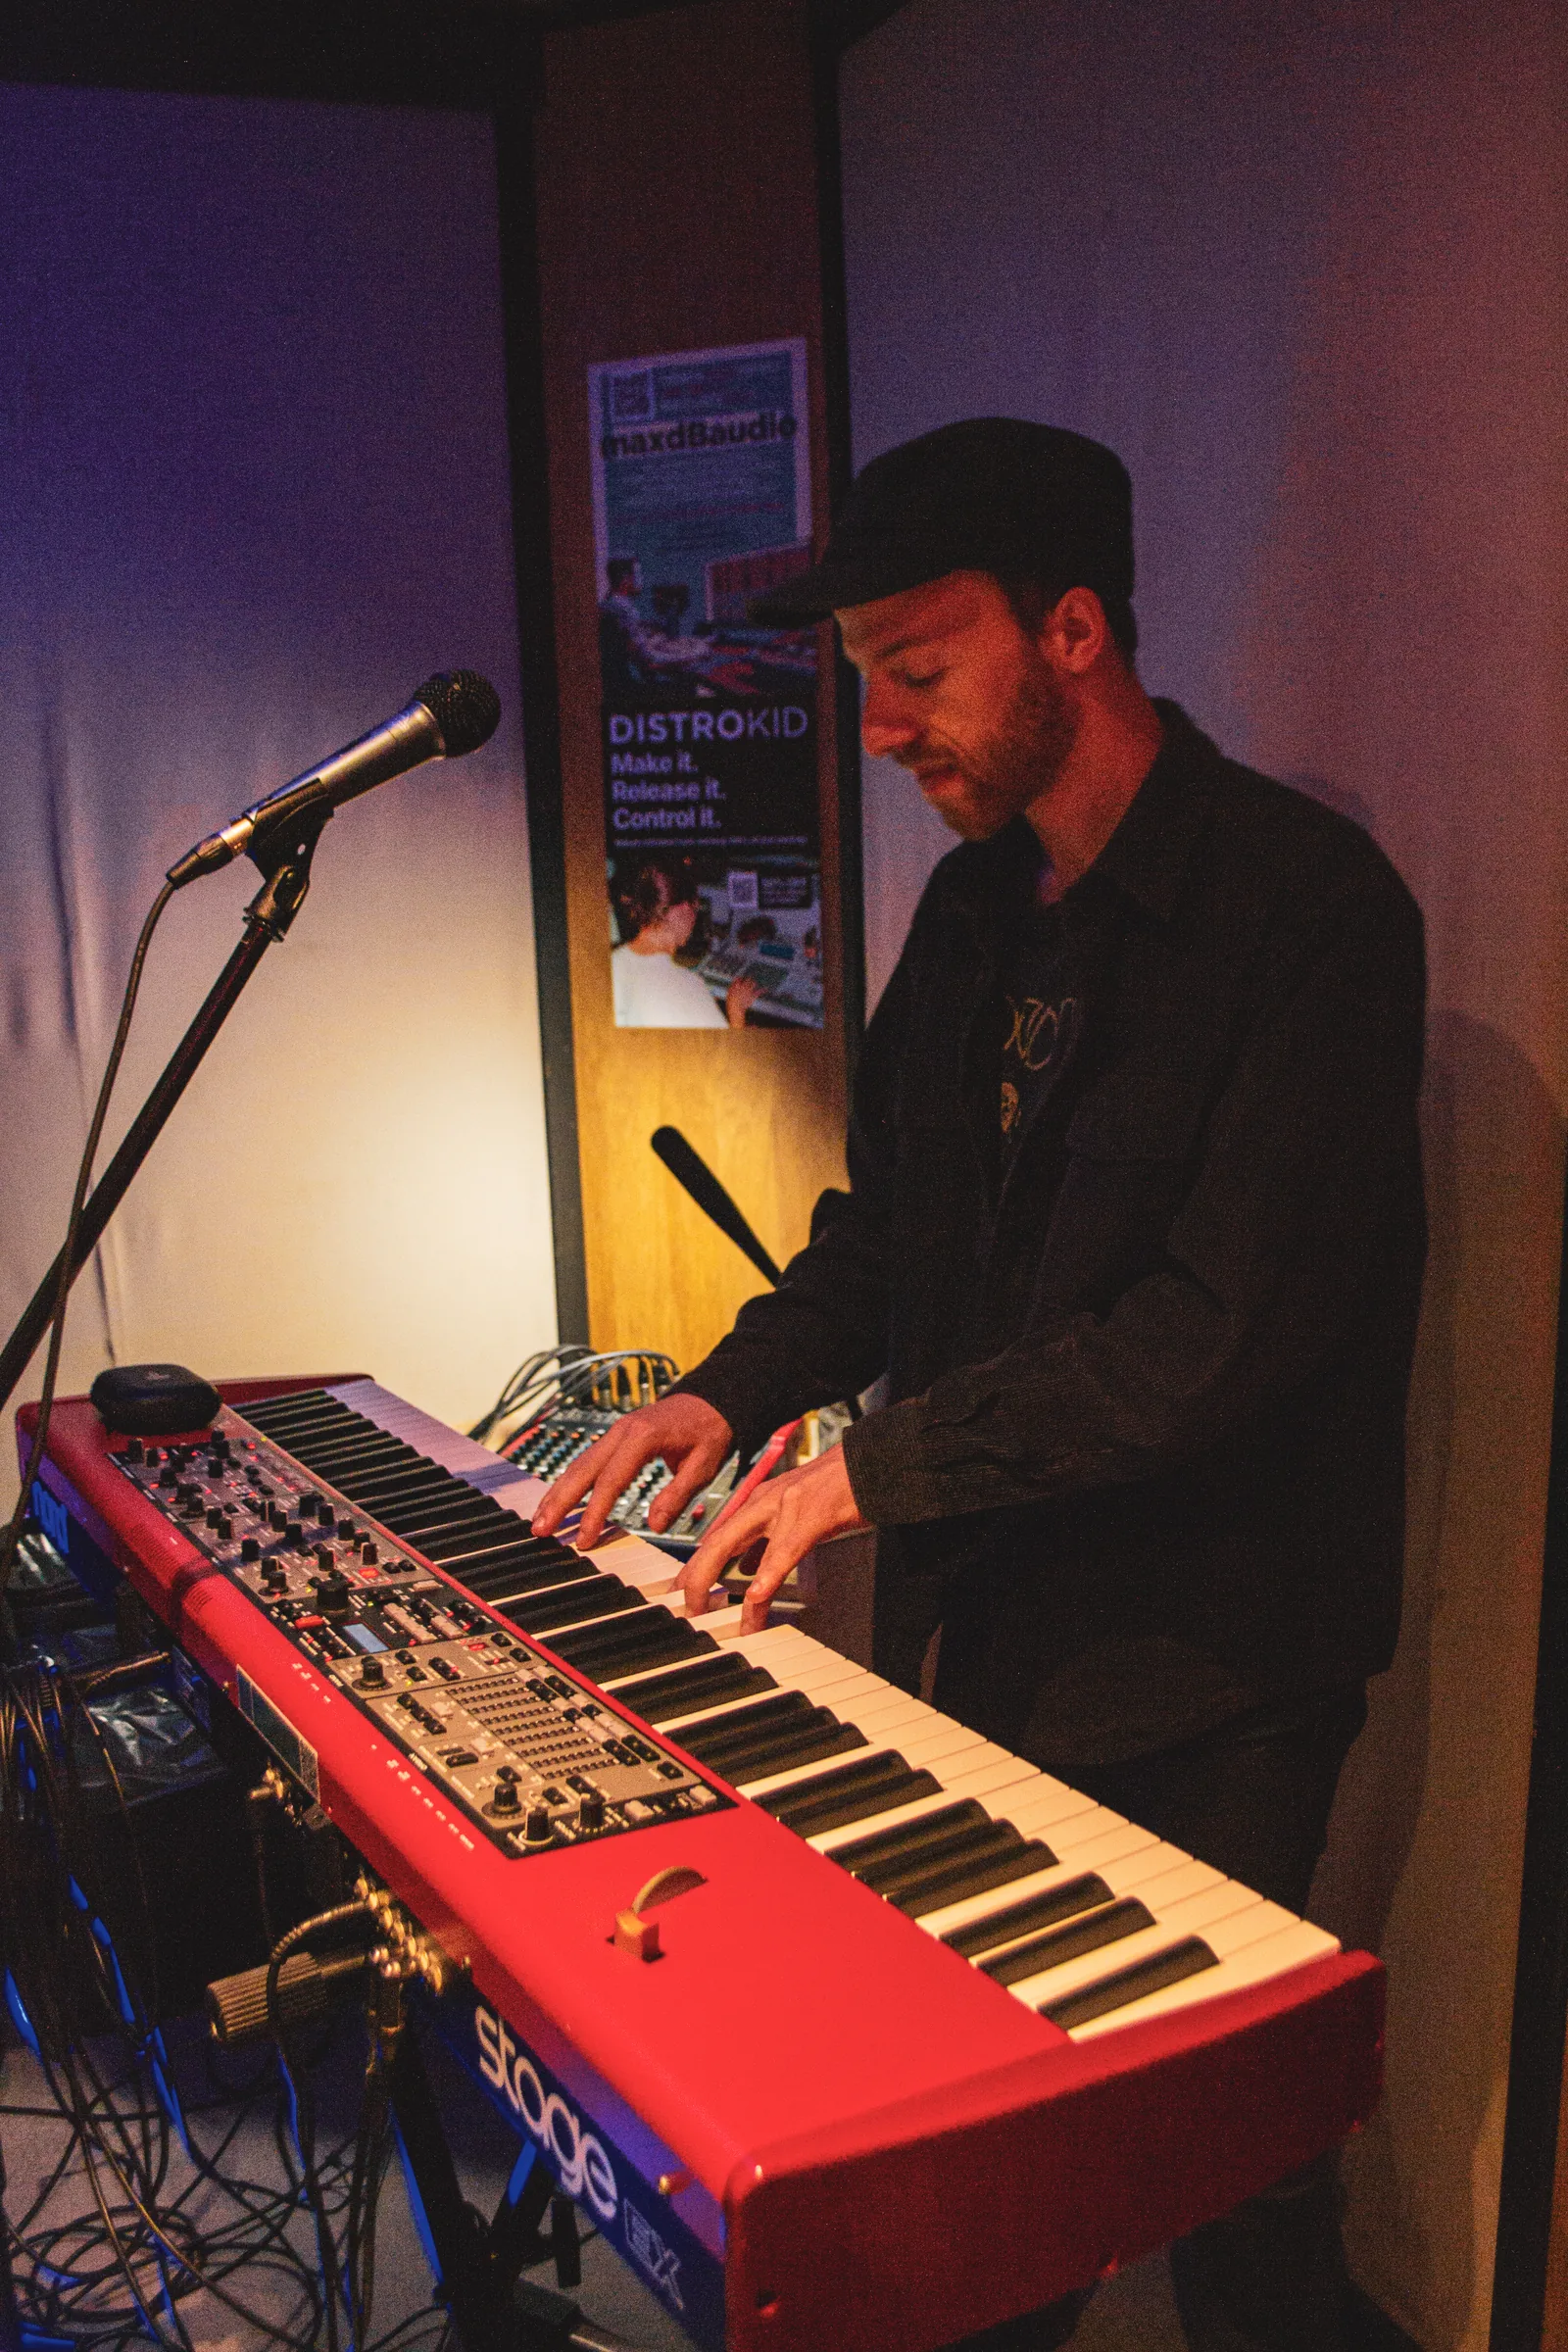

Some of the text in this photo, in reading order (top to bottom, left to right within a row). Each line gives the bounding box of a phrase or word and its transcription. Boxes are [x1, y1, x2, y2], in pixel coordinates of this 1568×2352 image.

[609, 706, 808, 745] DISTROKID
[610, 749, 699, 774] Make it.
[611, 780, 702, 803] Release
[612, 806, 722, 830] Control it.
[474, 2005, 618, 2222] stage
